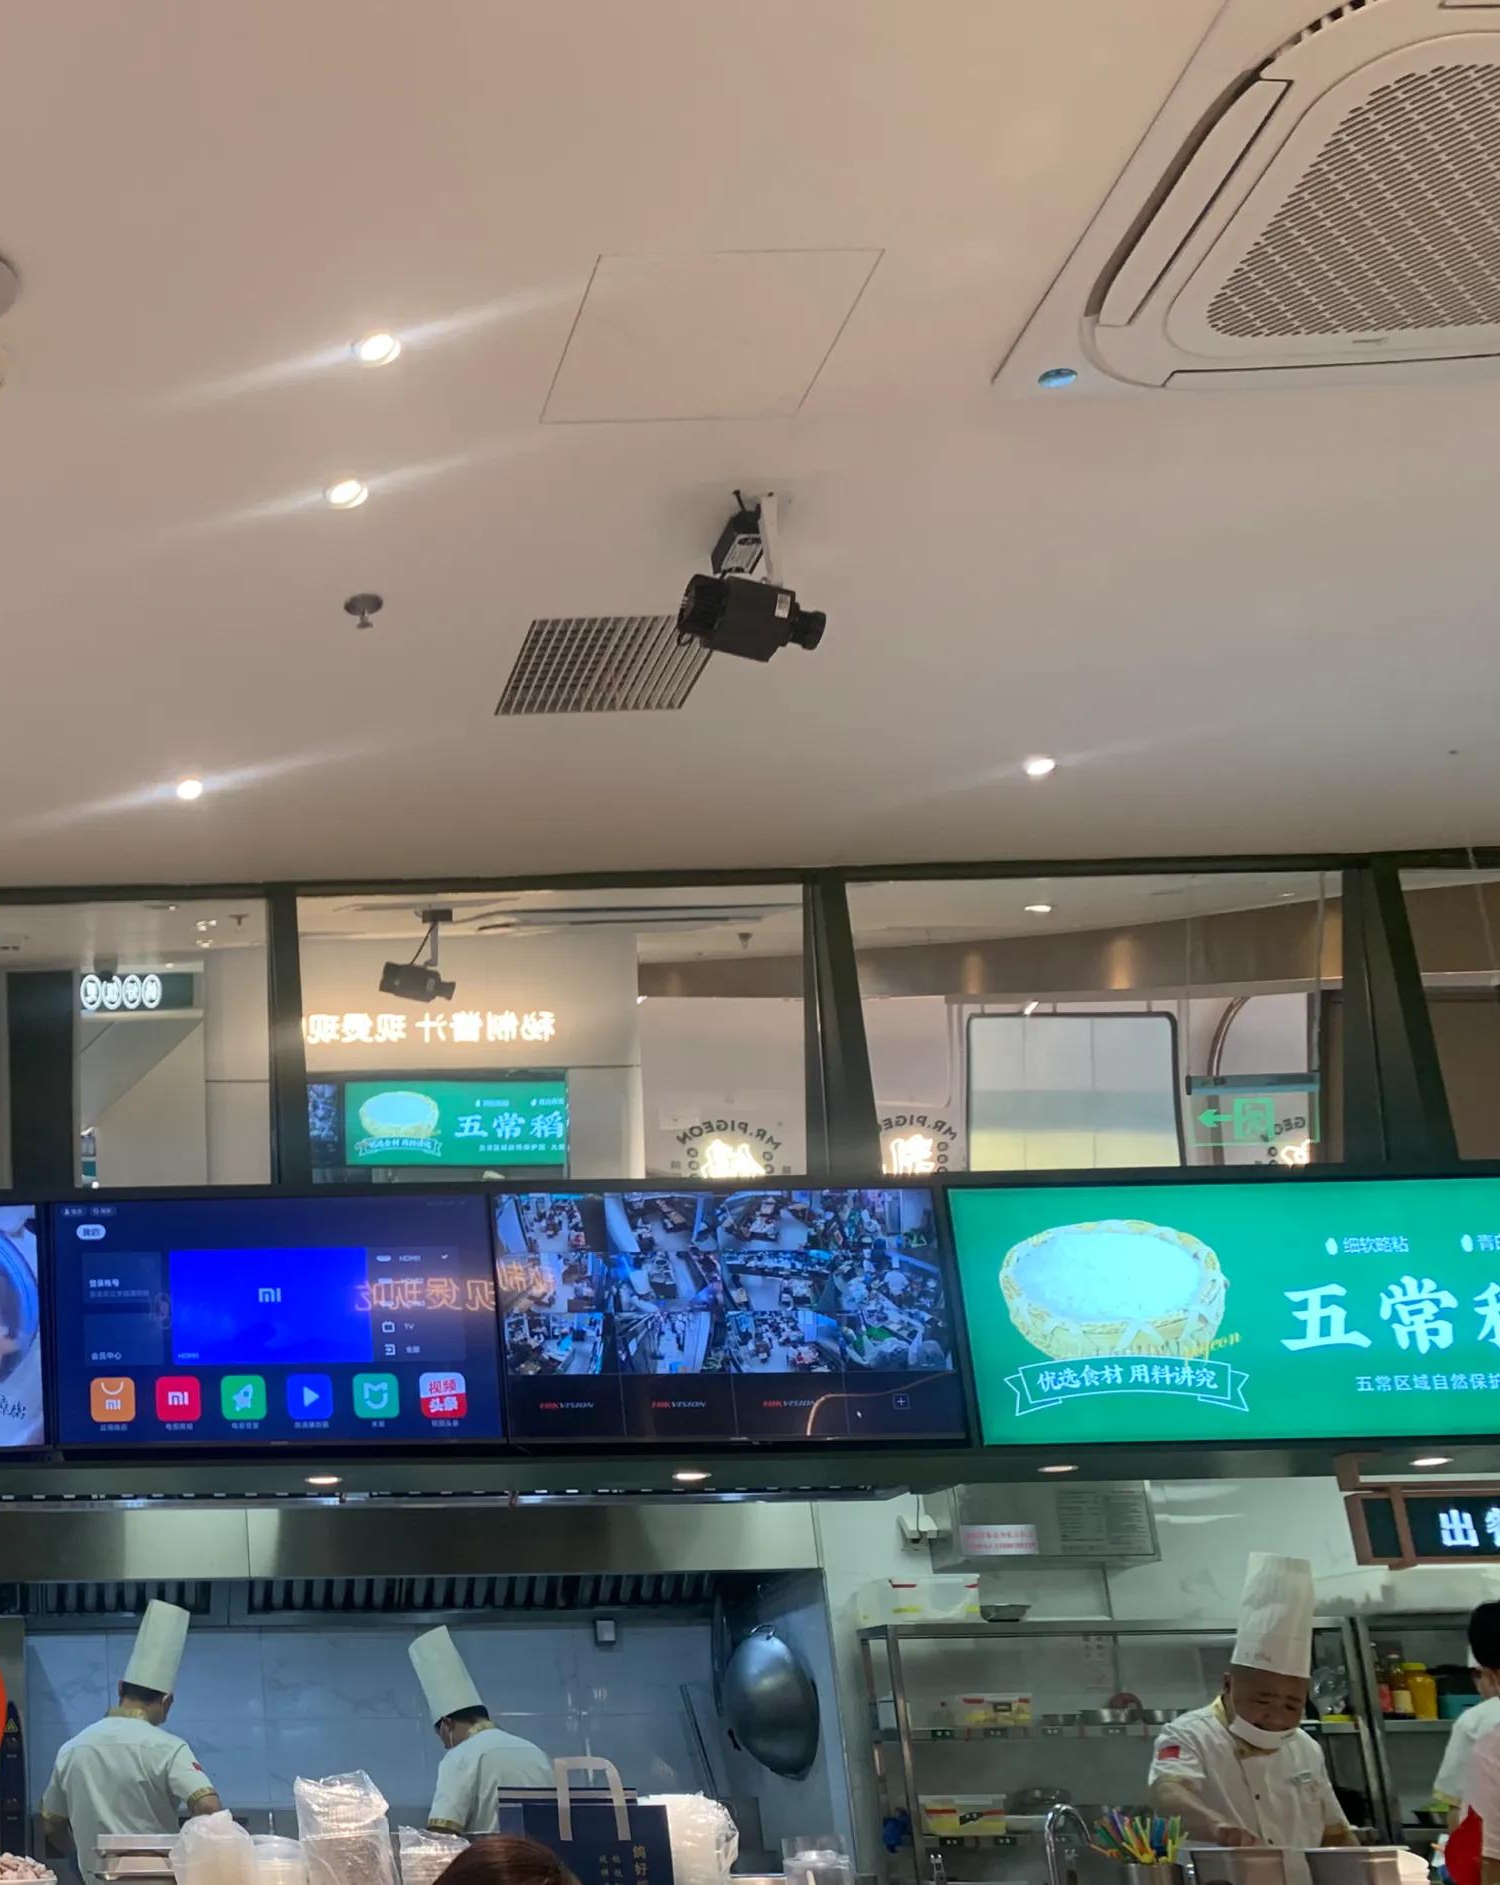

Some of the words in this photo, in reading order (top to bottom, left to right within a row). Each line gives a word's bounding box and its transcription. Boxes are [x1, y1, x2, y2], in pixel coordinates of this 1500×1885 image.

[1036, 1364, 1125, 1393] 优选食材
[1129, 1363, 1220, 1389] 用料讲究
